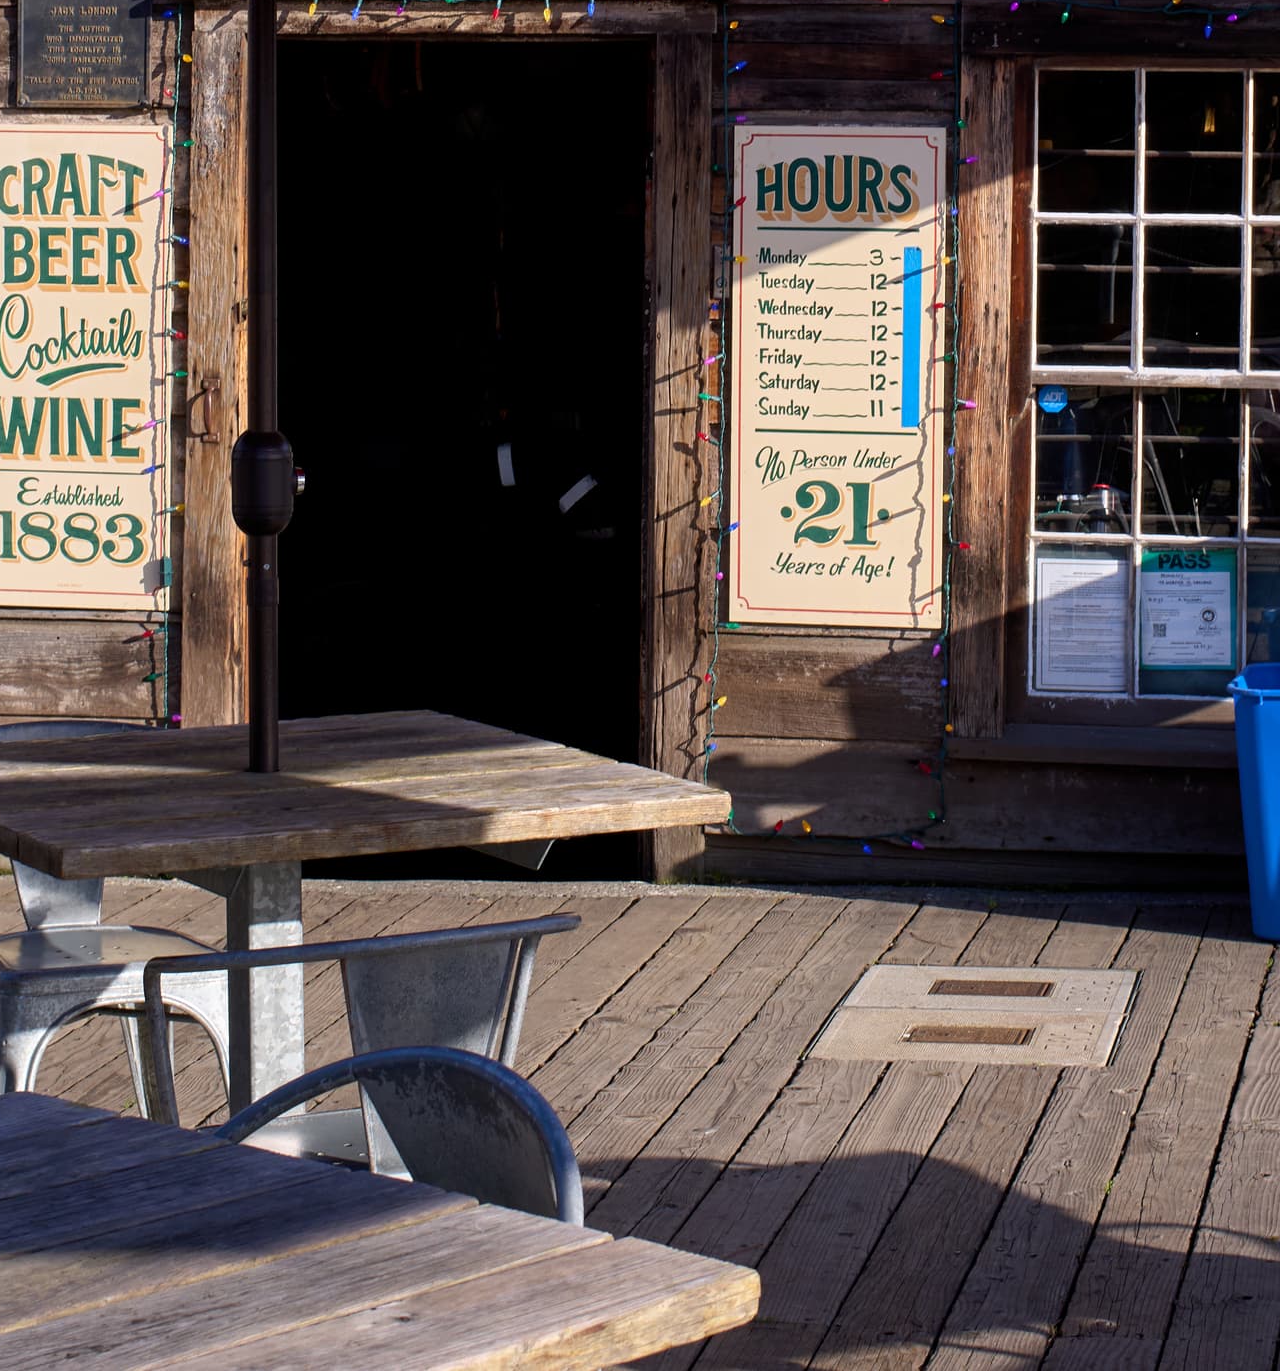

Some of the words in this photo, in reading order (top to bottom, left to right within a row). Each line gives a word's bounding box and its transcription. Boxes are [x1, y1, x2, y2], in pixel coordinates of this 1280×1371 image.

[51, 6, 74, 16] JACK
[80, 6, 118, 16] LONDON
[756, 155, 914, 217] HOURS
[2, 226, 144, 289] BEER
[758, 247, 808, 267] Monday
[870, 249, 884, 266] 3
[758, 272, 814, 293] Tuesday
[870, 274, 888, 290] 12
[758, 299, 833, 319] Wednesday
[871, 301, 888, 316] 12
[757, 323, 822, 343] Thursday
[871, 325, 888, 341] 12
[758, 348, 802, 368] Friday
[870, 350, 888, 366] 12
[758, 372, 820, 393] Saturday
[870, 375, 887, 390] 12
[1043, 391, 1065, 402] ADT
[758, 397, 810, 419] Sunday
[870, 400, 884, 417] 11
[755, 446, 786, 484] No
[790, 449, 847, 475] Person
[853, 448, 902, 469] Under
[17, 476, 124, 506] Established
[794, 480, 878, 546] 21
[770, 552, 824, 576] Years
[829, 556, 850, 576] of
[852, 555, 895, 583] Age!
[1158, 553, 1212, 570] PASS
